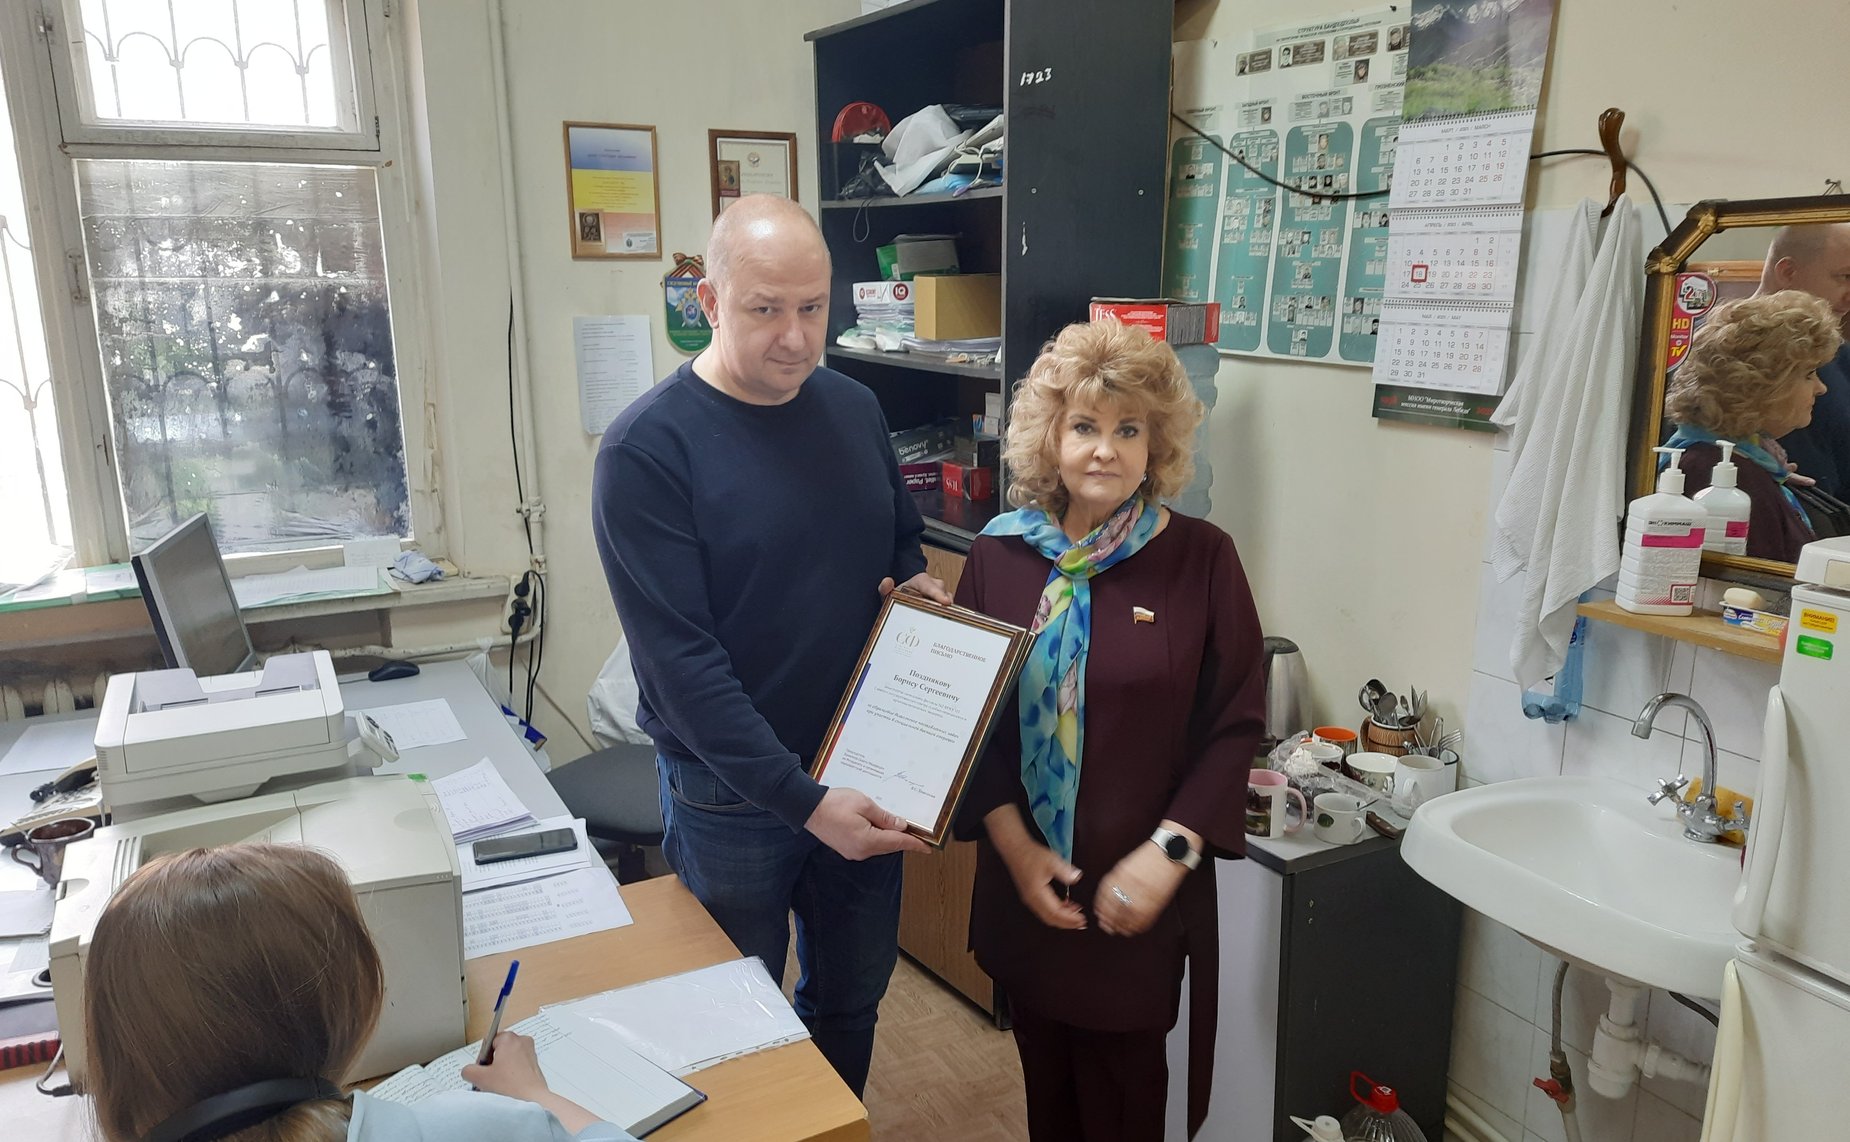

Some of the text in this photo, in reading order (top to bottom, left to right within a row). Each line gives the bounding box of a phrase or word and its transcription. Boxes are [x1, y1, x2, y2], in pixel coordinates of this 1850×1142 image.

[1020, 68, 1052, 86] 1723
[1672, 318, 1690, 329] HD
[1670, 345, 1687, 357] TV
[898, 440, 926, 455] benovy
[909, 669, 951, 690] Позднякову
[894, 674, 960, 702] Борису Сергеевичу
